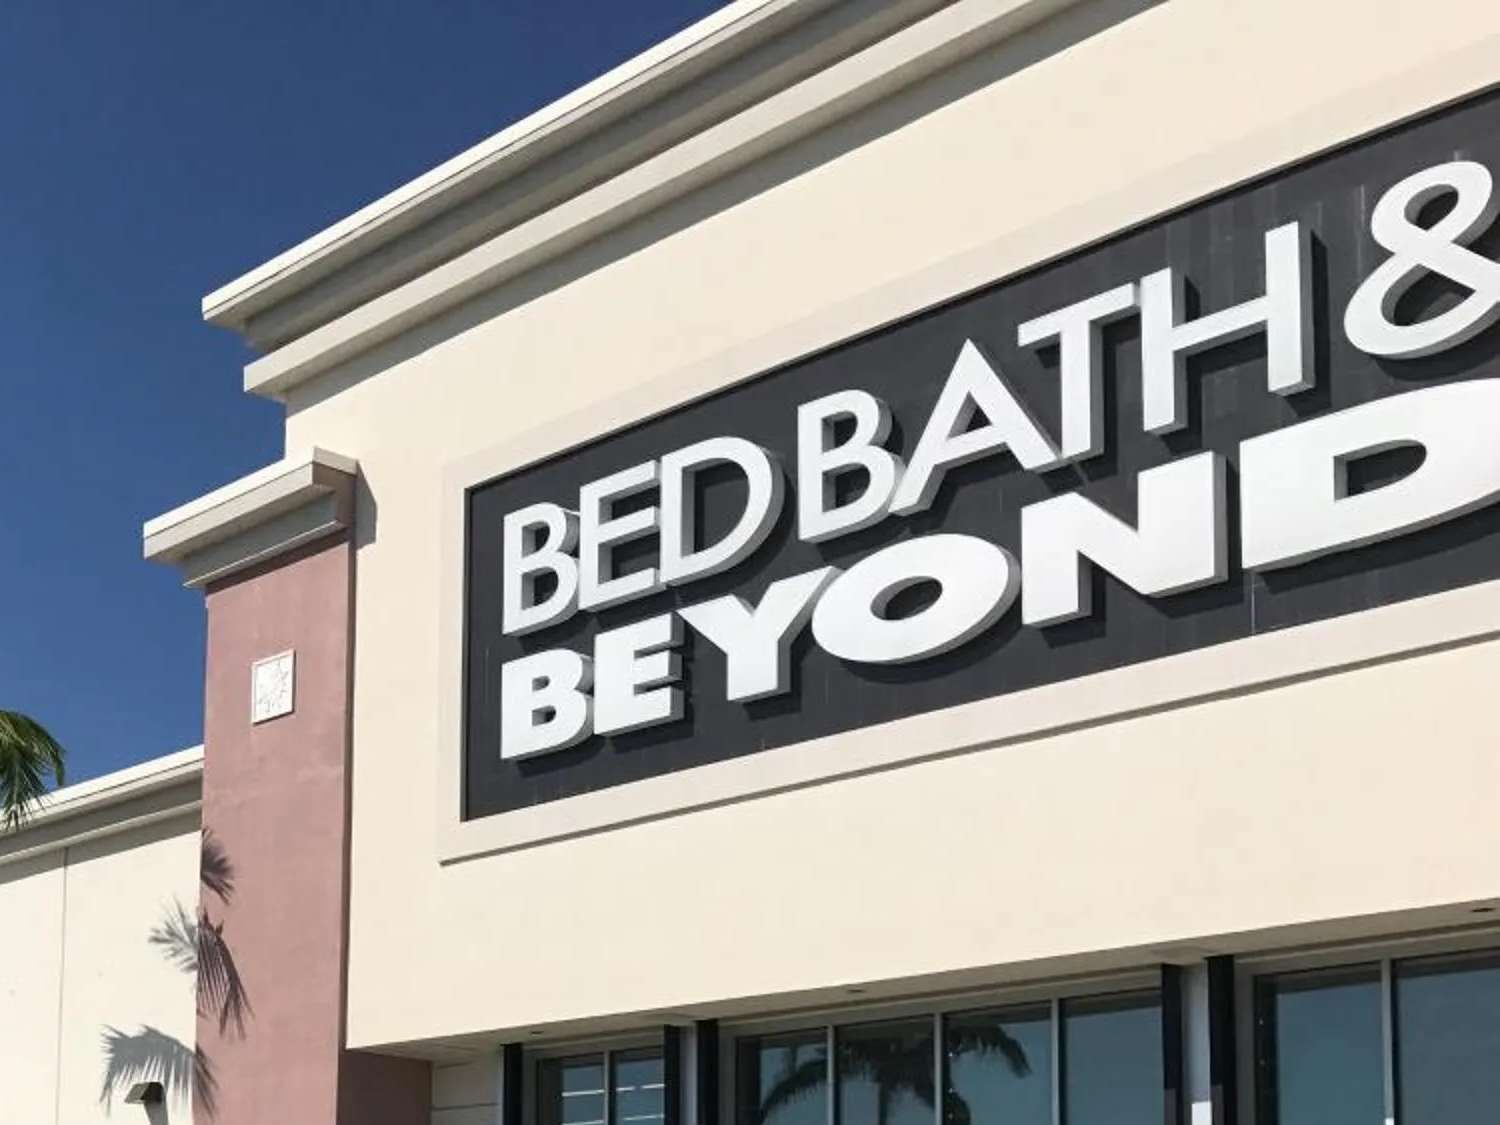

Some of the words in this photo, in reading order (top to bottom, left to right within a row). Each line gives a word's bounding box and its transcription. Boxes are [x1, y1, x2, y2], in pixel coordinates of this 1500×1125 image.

[501, 377, 1500, 760] BEYOND
[503, 436, 784, 636] BED
[797, 221, 1316, 542] BATH
[1343, 160, 1500, 360] &
